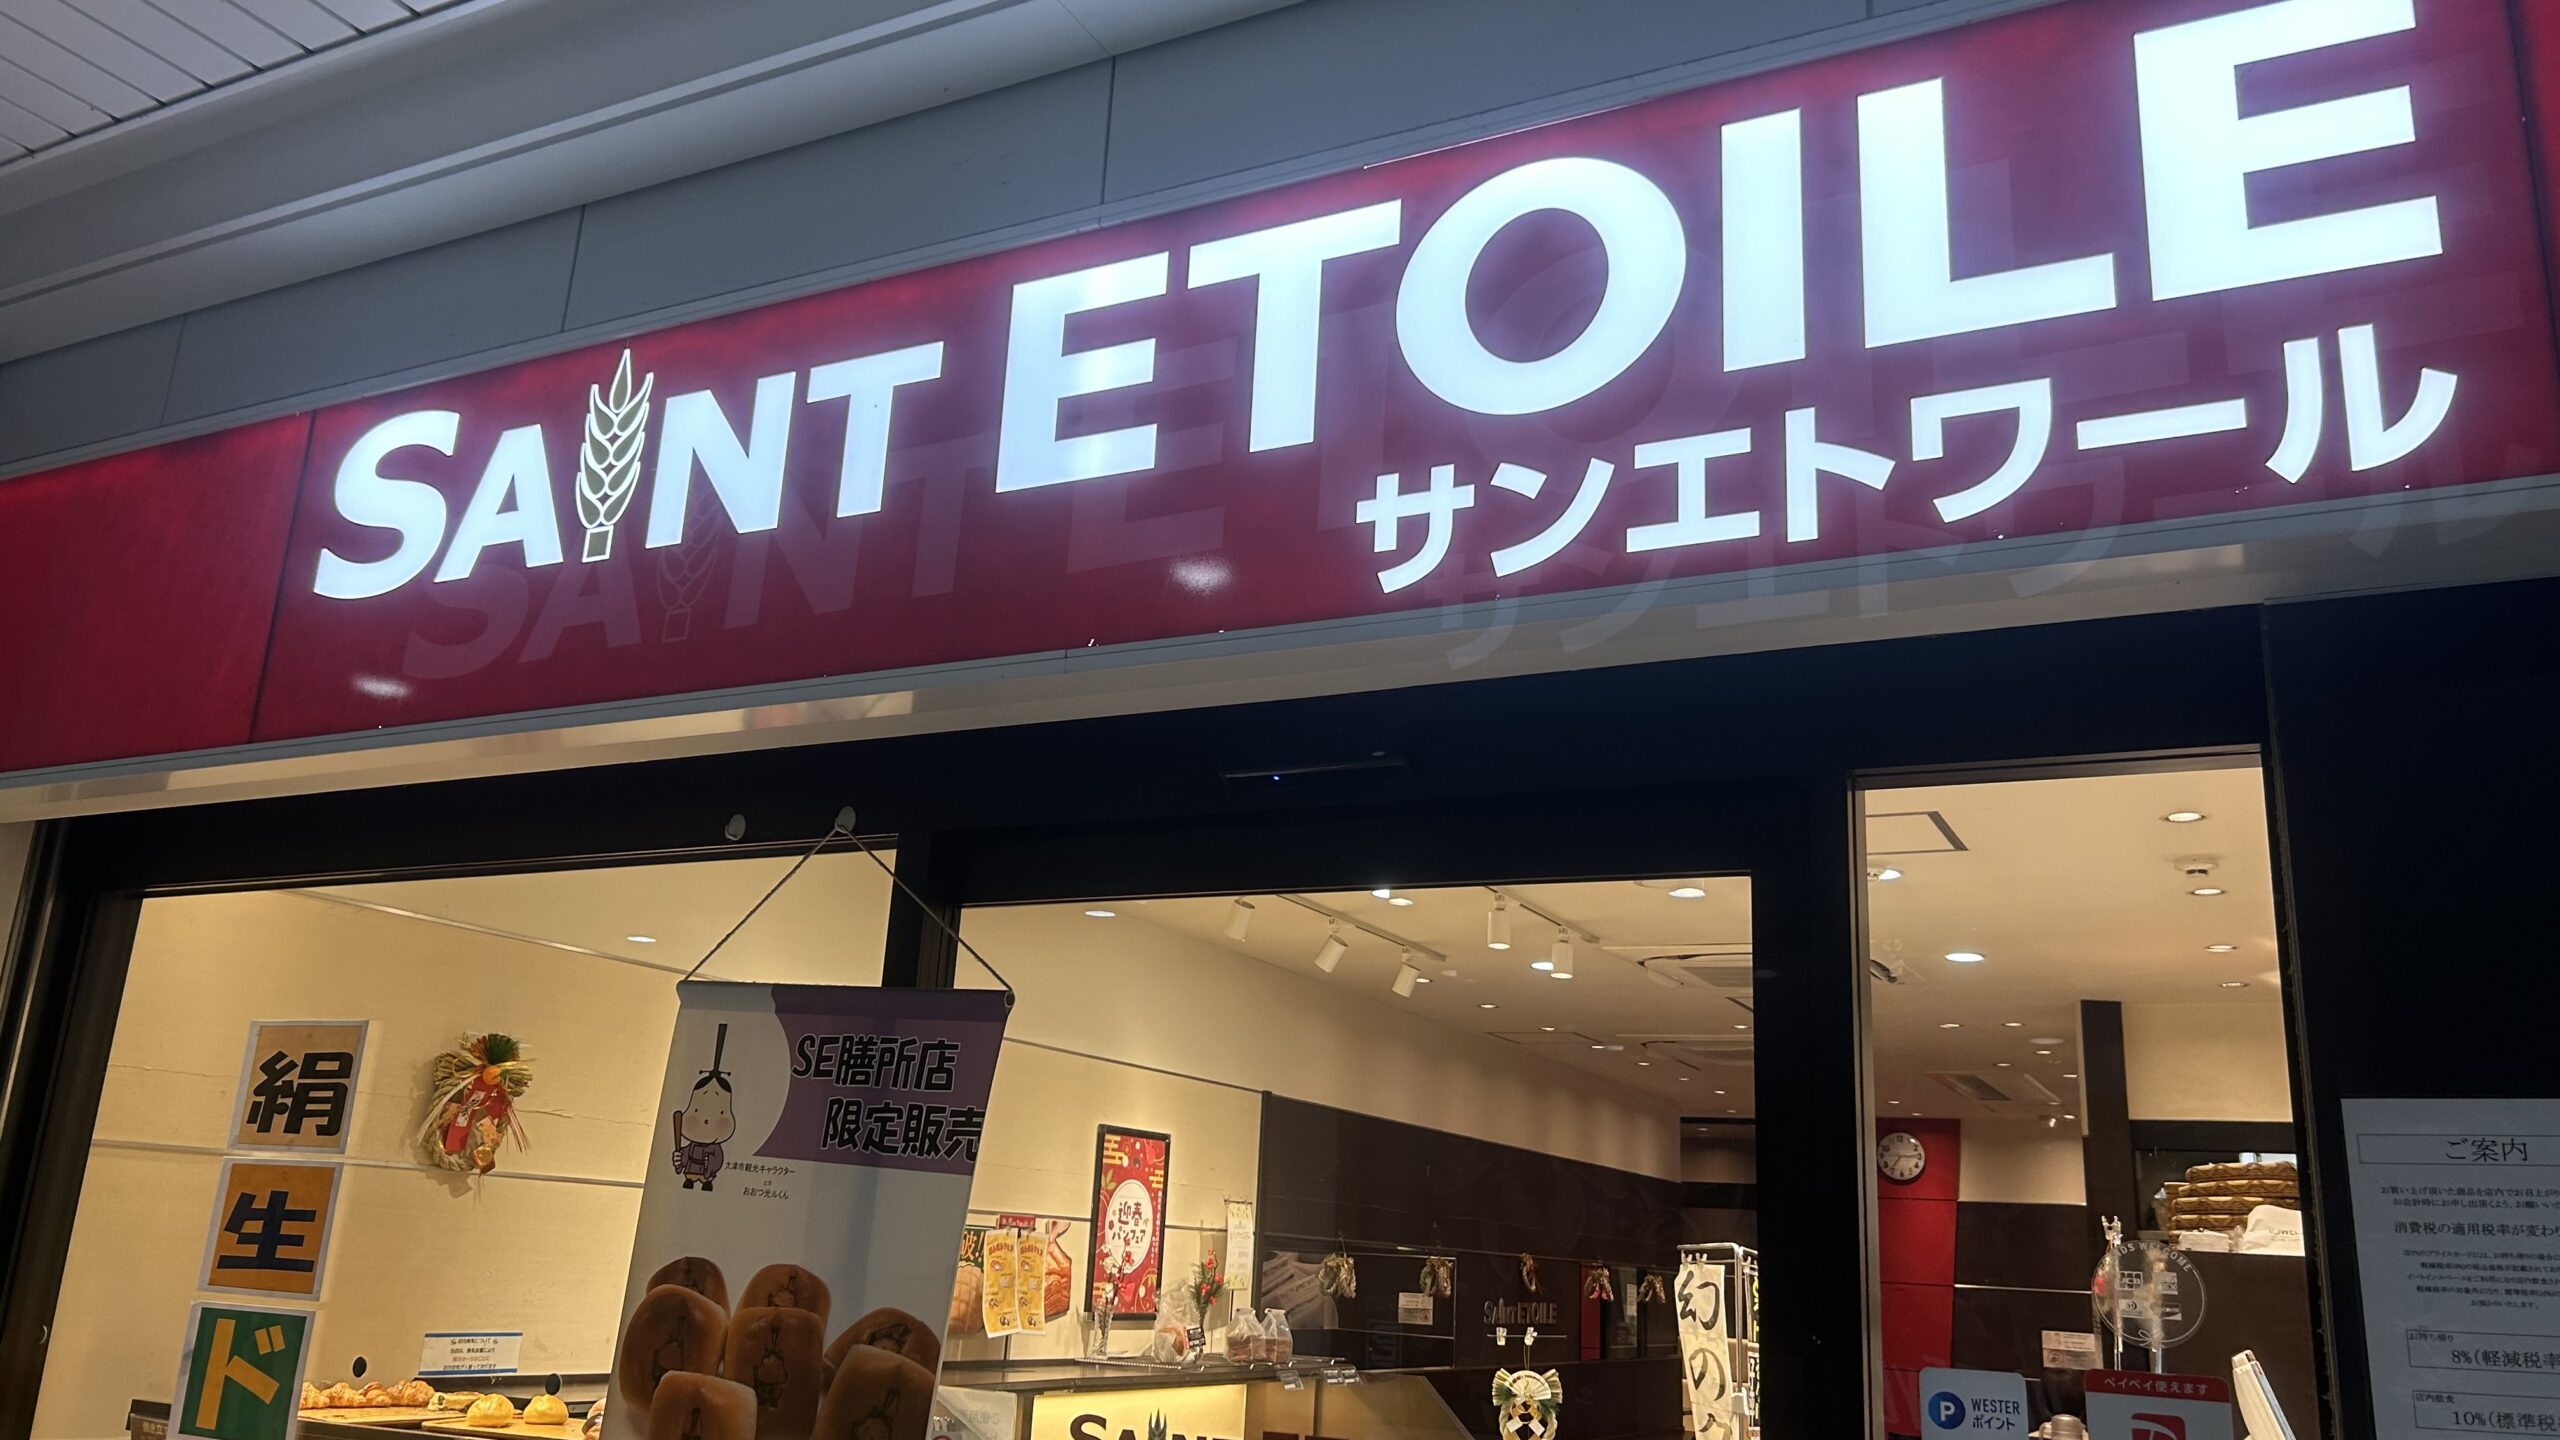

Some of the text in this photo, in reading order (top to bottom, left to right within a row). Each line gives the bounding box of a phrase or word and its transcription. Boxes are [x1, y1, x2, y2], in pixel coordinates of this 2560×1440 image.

[996, 0, 2444, 493] ETOILE
[1355, 324, 2458, 594] サンエトワール
[792, 1033, 960, 1092] SE膳所店
[821, 1097, 986, 1163] 限定販売
[2445, 1137, 2529, 1162] ご案内
[725, 1161, 796, 1176] 大津市観光キャラクター
[1118, 1201, 1143, 1226] 迎春
[195, 1050, 353, 1430] 絹 生 ド
[1518, 1302, 1559, 1325] ETOILE
[2104, 1378, 2208, 1395] ペイペイ使えます
[2415, 1393, 2455, 1404] 店内飲食
[1971, 1398, 2020, 1416] WESTER
[1972, 1414, 2017, 1431] ポイント
[2453, 1411, 2560, 1432] 10%(標準税
